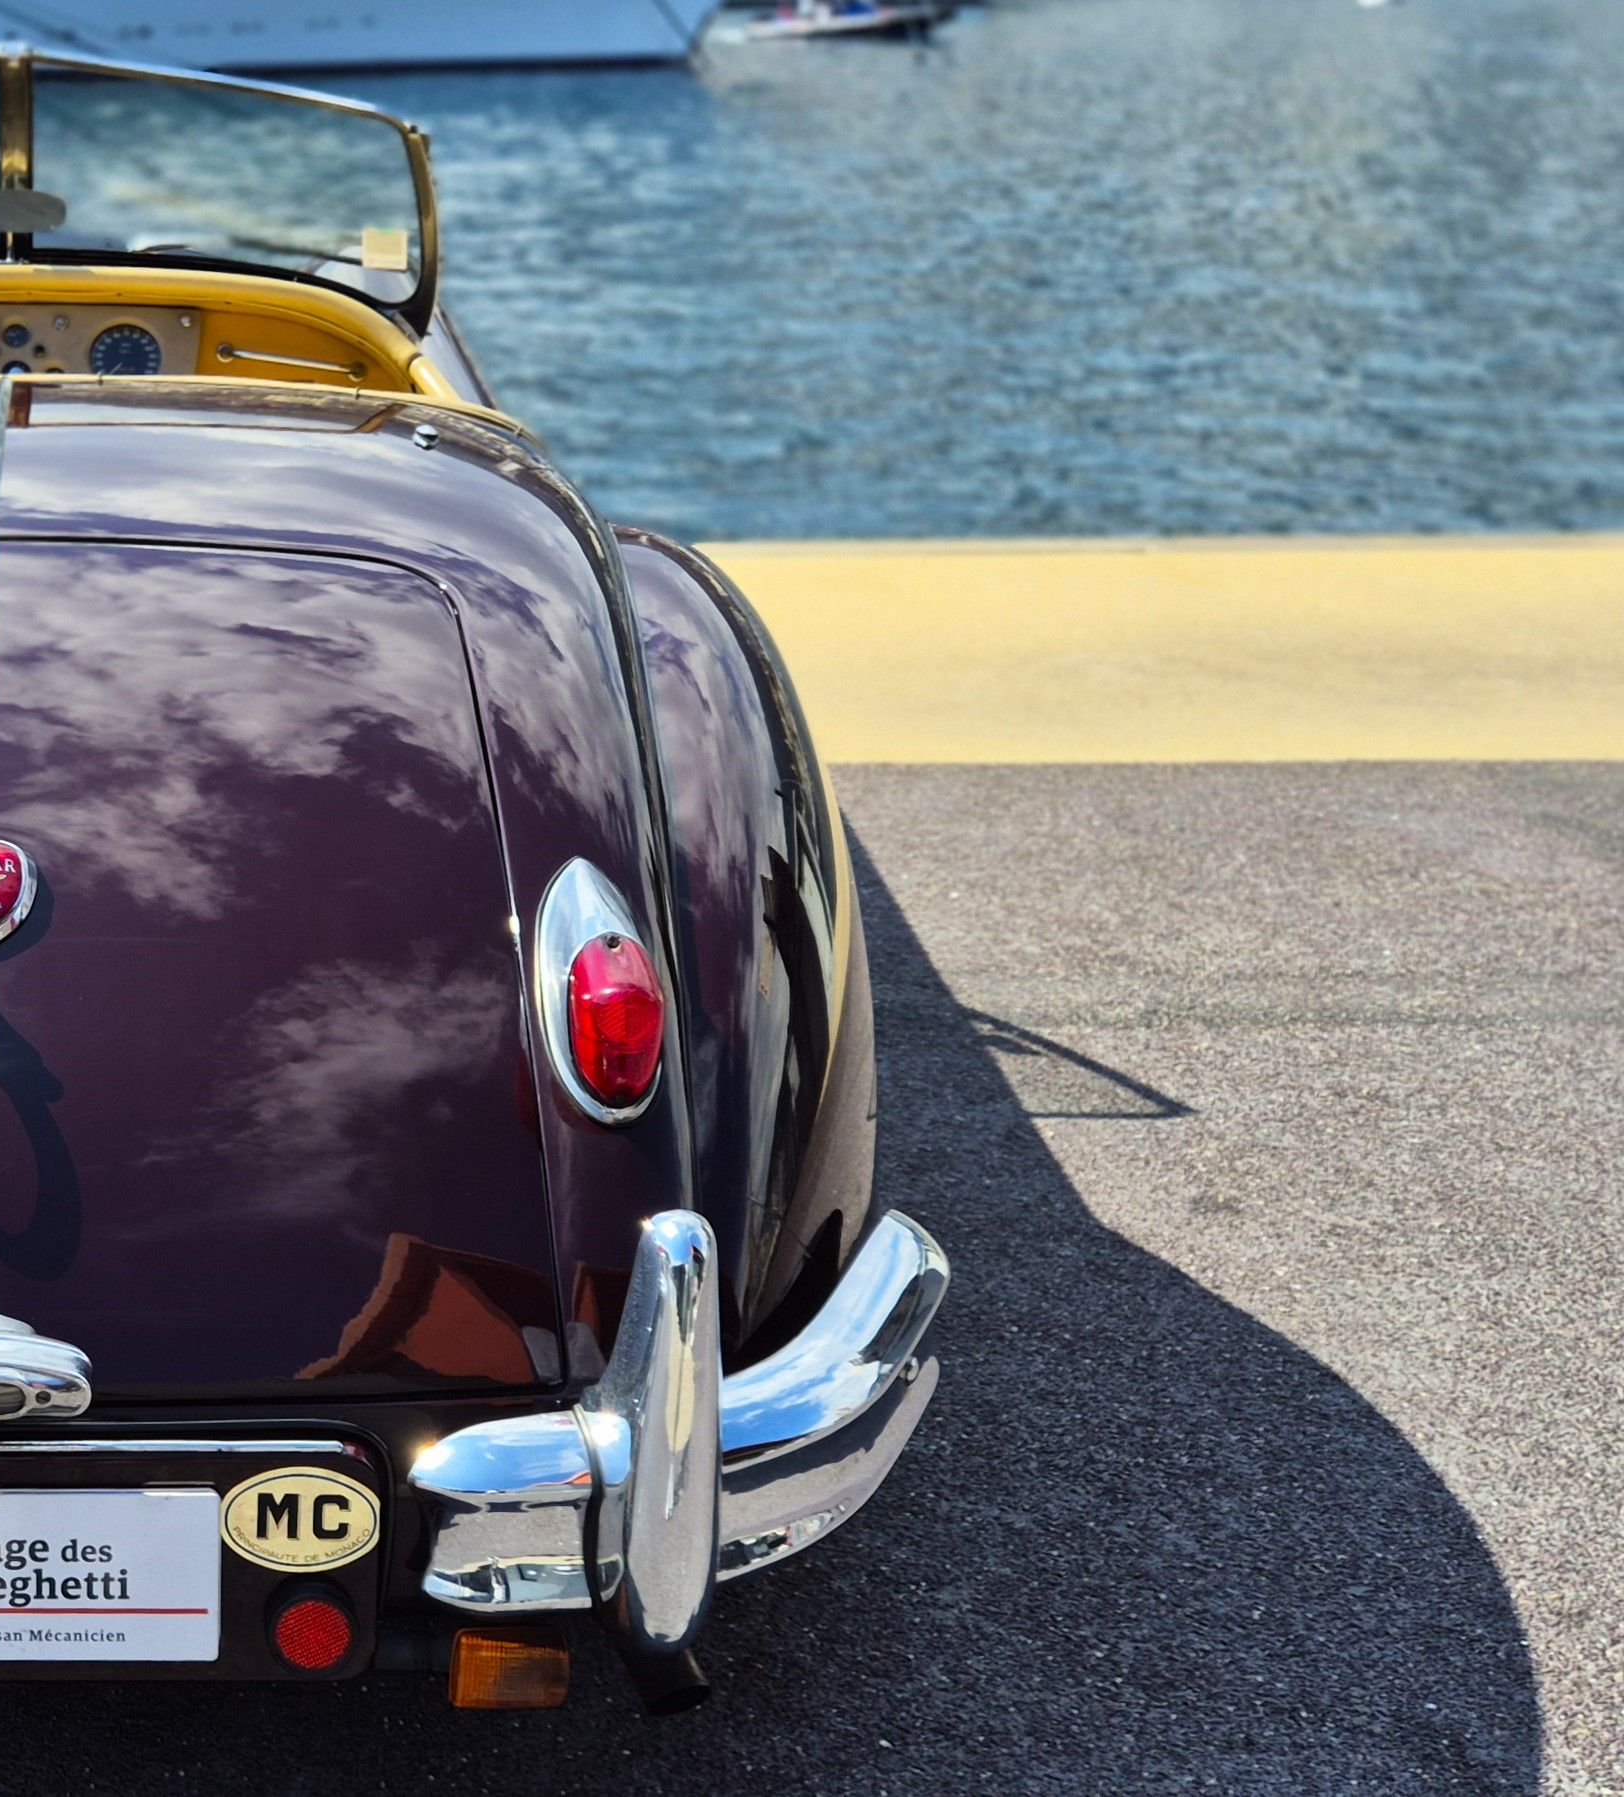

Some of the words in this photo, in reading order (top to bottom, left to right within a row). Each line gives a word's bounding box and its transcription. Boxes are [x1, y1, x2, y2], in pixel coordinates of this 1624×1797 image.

[256, 1493, 351, 1540] MC
[61, 1539, 113, 1563] des
[304, 1553, 321, 1563] DE
[324, 1528, 371, 1559] MONACO
[29, 1628, 126, 1643] Mécanicien
